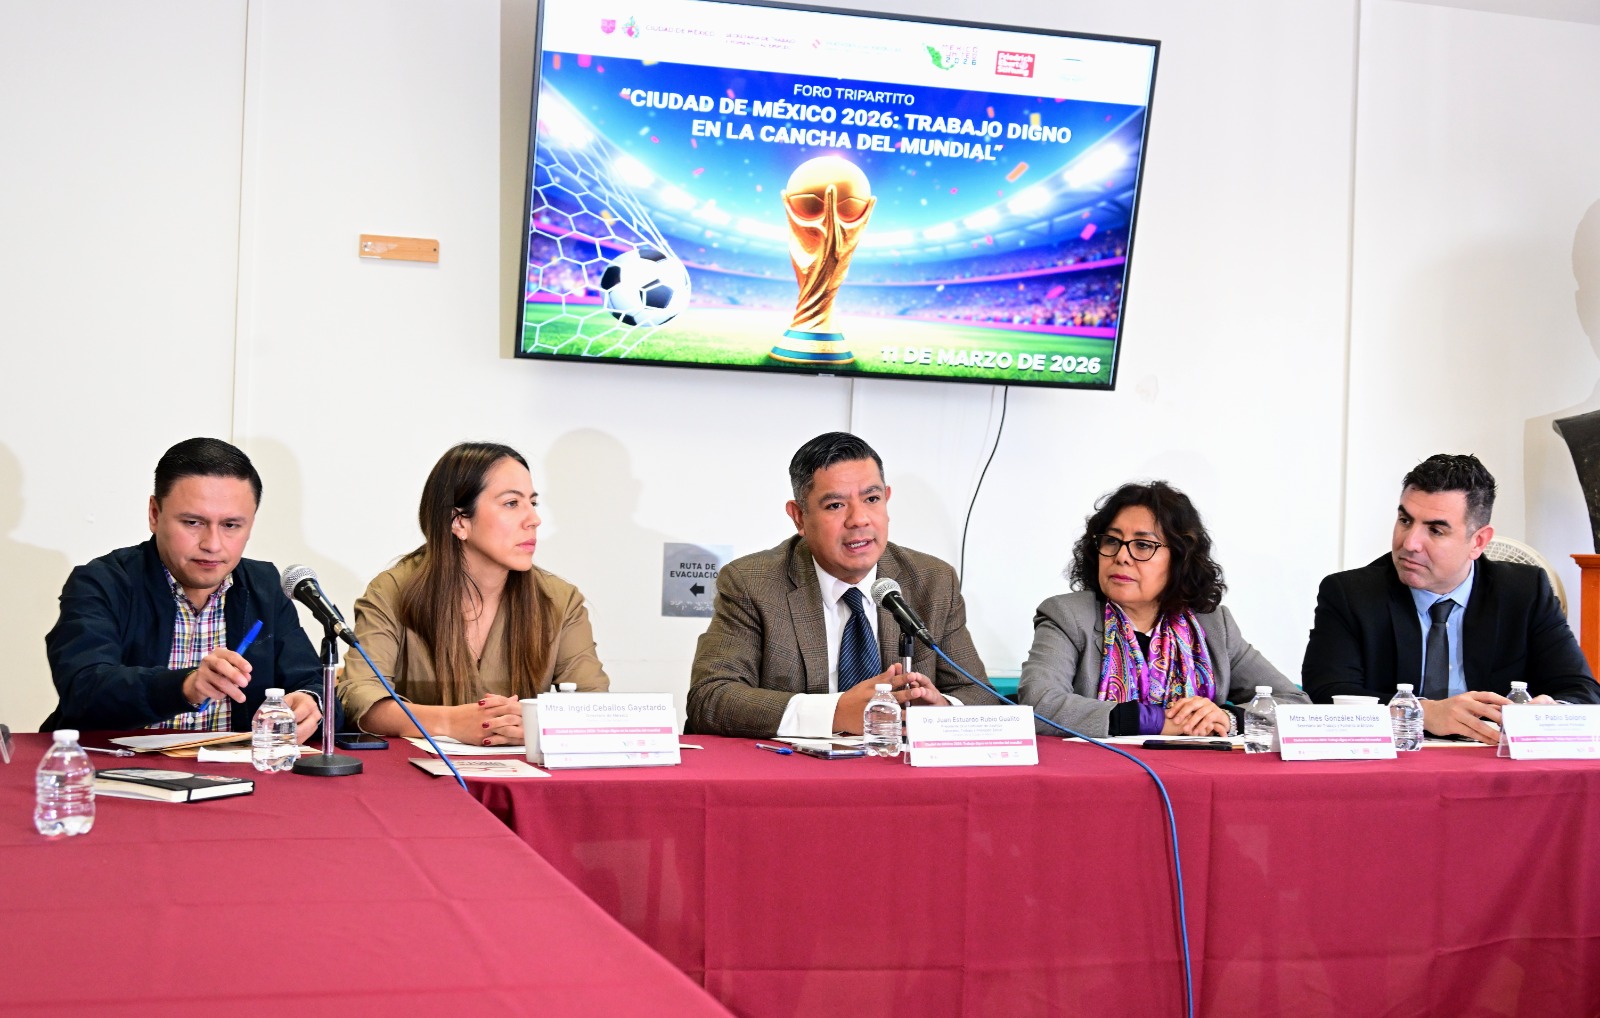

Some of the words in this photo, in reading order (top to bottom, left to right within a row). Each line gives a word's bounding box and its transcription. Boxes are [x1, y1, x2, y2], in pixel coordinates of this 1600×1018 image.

[793, 83, 832, 99] FORO
[834, 87, 915, 106] TRIPARTITO
[719, 97, 749, 116] DE
[752, 99, 837, 124] MÉXICO
[841, 108, 900, 129] 2026:
[904, 113, 1003, 138] TRABAJO
[1007, 122, 1072, 144] DIGNO
[692, 119, 722, 138] EN
[726, 122, 755, 141] LA
[760, 125, 852, 150] CANCHA
[856, 133, 896, 153] DEL
[881, 346, 897, 363] 11
[903, 347, 932, 365] DE
[937, 349, 1014, 369] MARZO
[1017, 353, 1047, 371] DE
[1050, 355, 1102, 375] 2026
[680, 562, 703, 570] RUTA
[568, 704, 591, 713] Ingrid
[592, 704, 626, 712] Ceballos
[628, 704, 667, 713] Gaystardo
[999, 715, 1020, 723] Gualito
[1289, 714, 1306, 722] Mtra.
